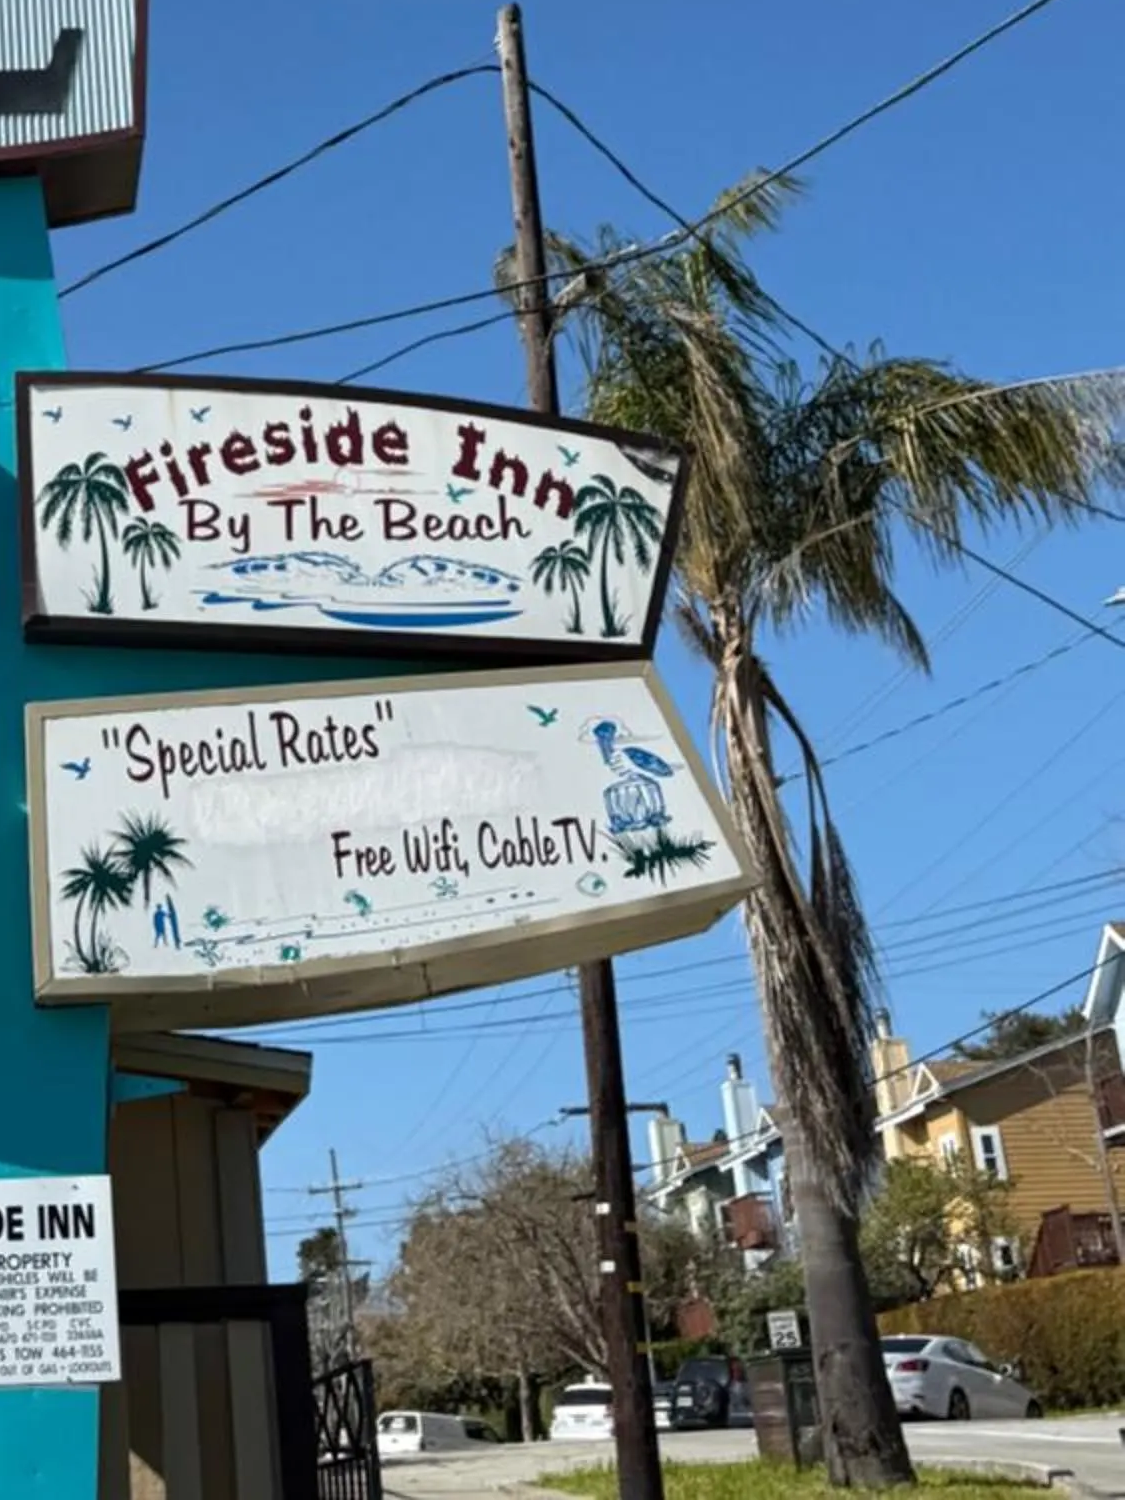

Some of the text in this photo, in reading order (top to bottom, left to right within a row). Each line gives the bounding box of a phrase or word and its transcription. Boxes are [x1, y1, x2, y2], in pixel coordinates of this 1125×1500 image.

[123, 404, 574, 520] Fireside Inn
[178, 494, 531, 553] By The Beach
[102, 700, 394, 800] "Special Rates"
[331, 830, 396, 878] Free
[402, 817, 469, 877] Wifi,
[37, 1203, 96, 1240] INN
[47, 1270, 74, 1283] WILL
[83, 1268, 98, 1283] BE
[35, 1284, 87, 1299] EXPENSE
[34, 1300, 104, 1316] PROHIBITED
[776, 1331, 798, 1348] 25
[14, 1346, 43, 1361] TOW
[37, 1362, 58, 1375] GAS
